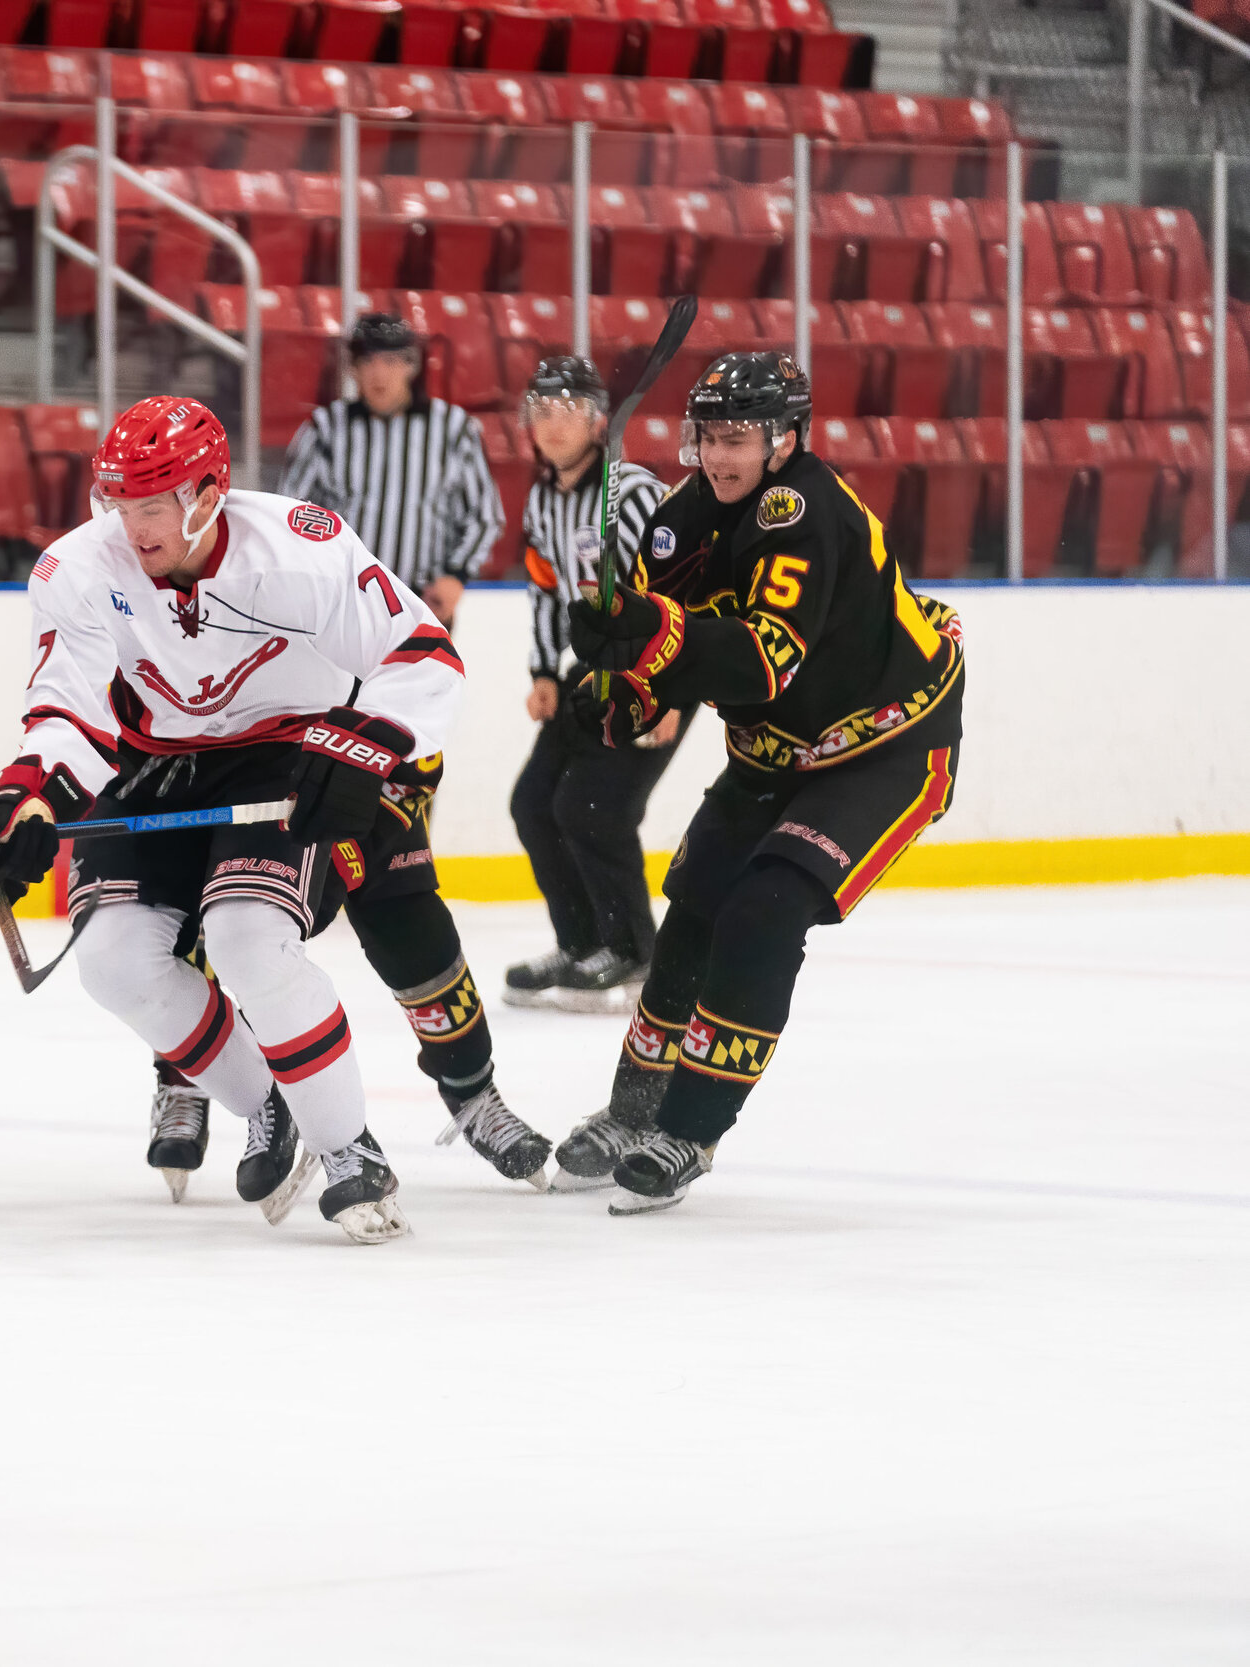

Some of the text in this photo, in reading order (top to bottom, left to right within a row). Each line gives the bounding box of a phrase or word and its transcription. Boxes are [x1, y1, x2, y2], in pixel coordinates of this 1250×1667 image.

[167, 405, 191, 425] NJT
[357, 563, 404, 618] 7
[26, 629, 57, 690] 7
[141, 808, 230, 830] NEXUS
[212, 857, 299, 884] BAUER
